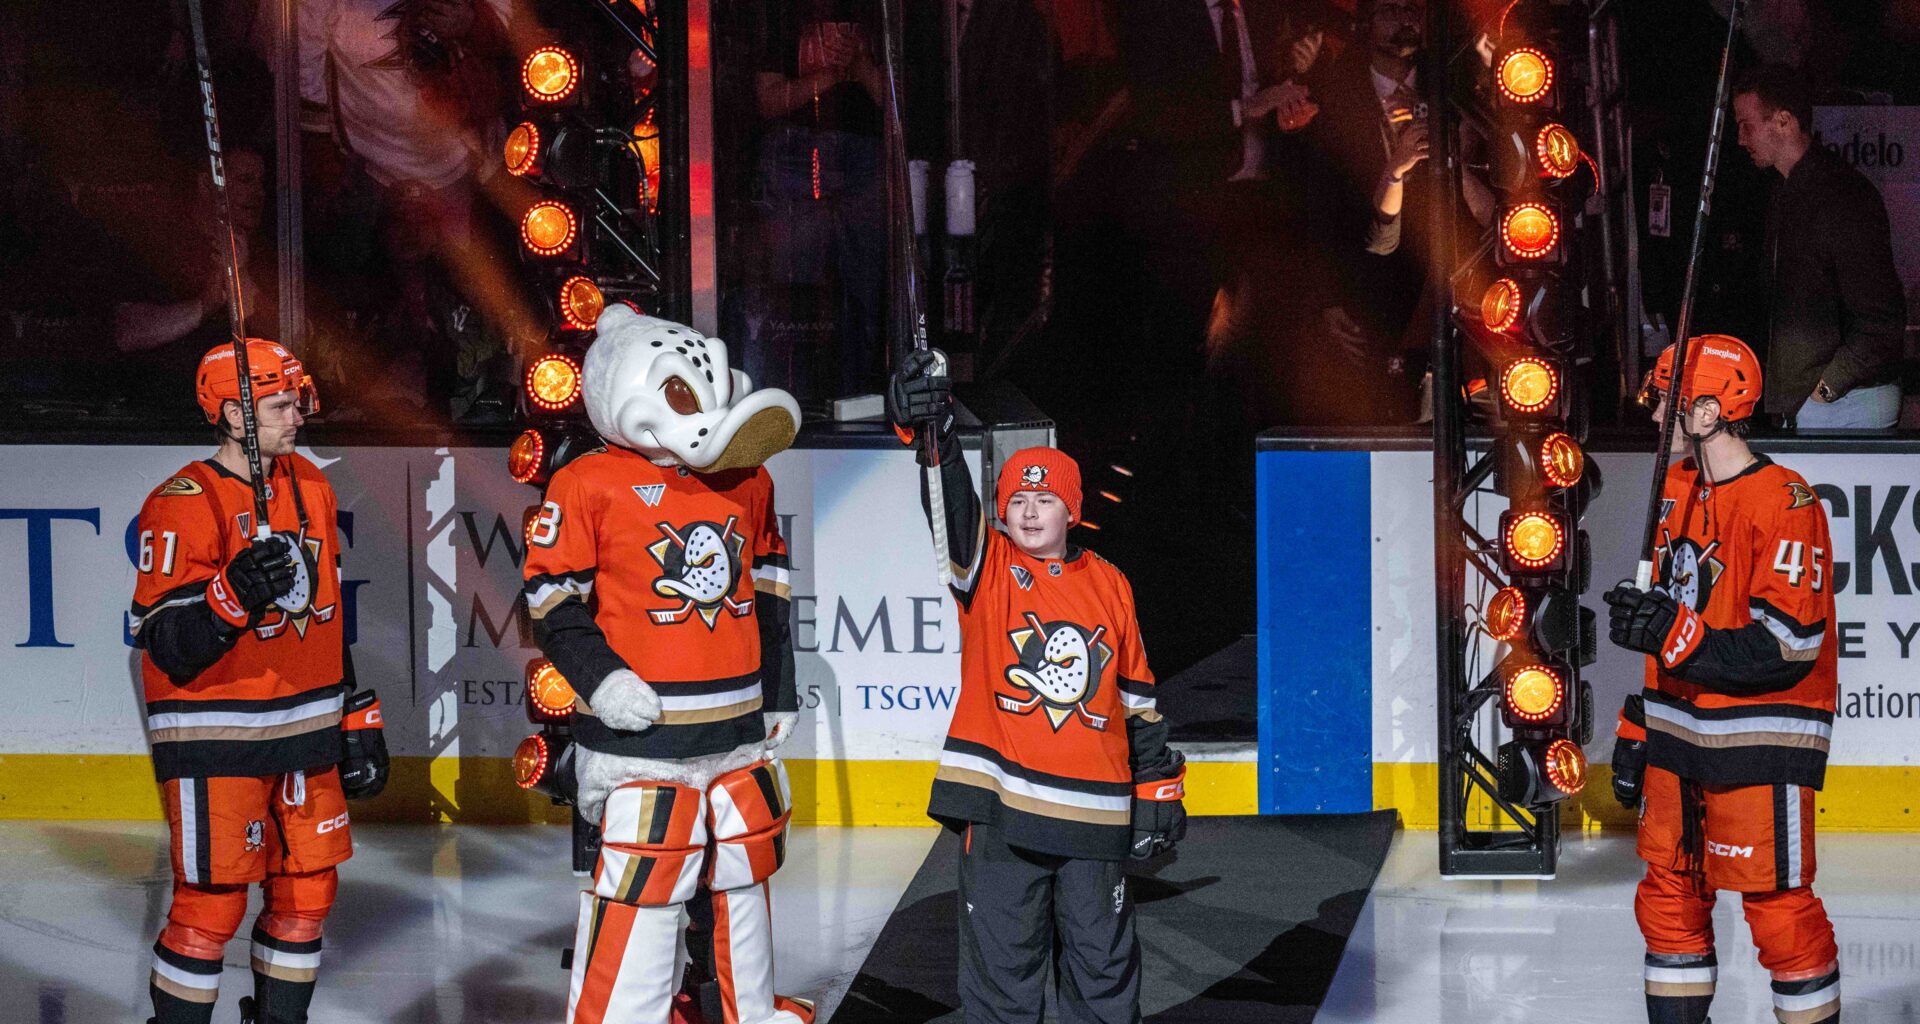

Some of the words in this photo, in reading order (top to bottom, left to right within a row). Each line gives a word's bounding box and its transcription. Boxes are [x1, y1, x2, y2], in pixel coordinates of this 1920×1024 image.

[1702, 346, 1741, 362] Disneyland
[139, 530, 178, 577] 61
[1773, 539, 1825, 594] 45
[462, 680, 525, 706] EST
[343, 770, 361, 779] CCM
[1134, 836, 1152, 849] CCM
[1708, 840, 1755, 858] CCM
